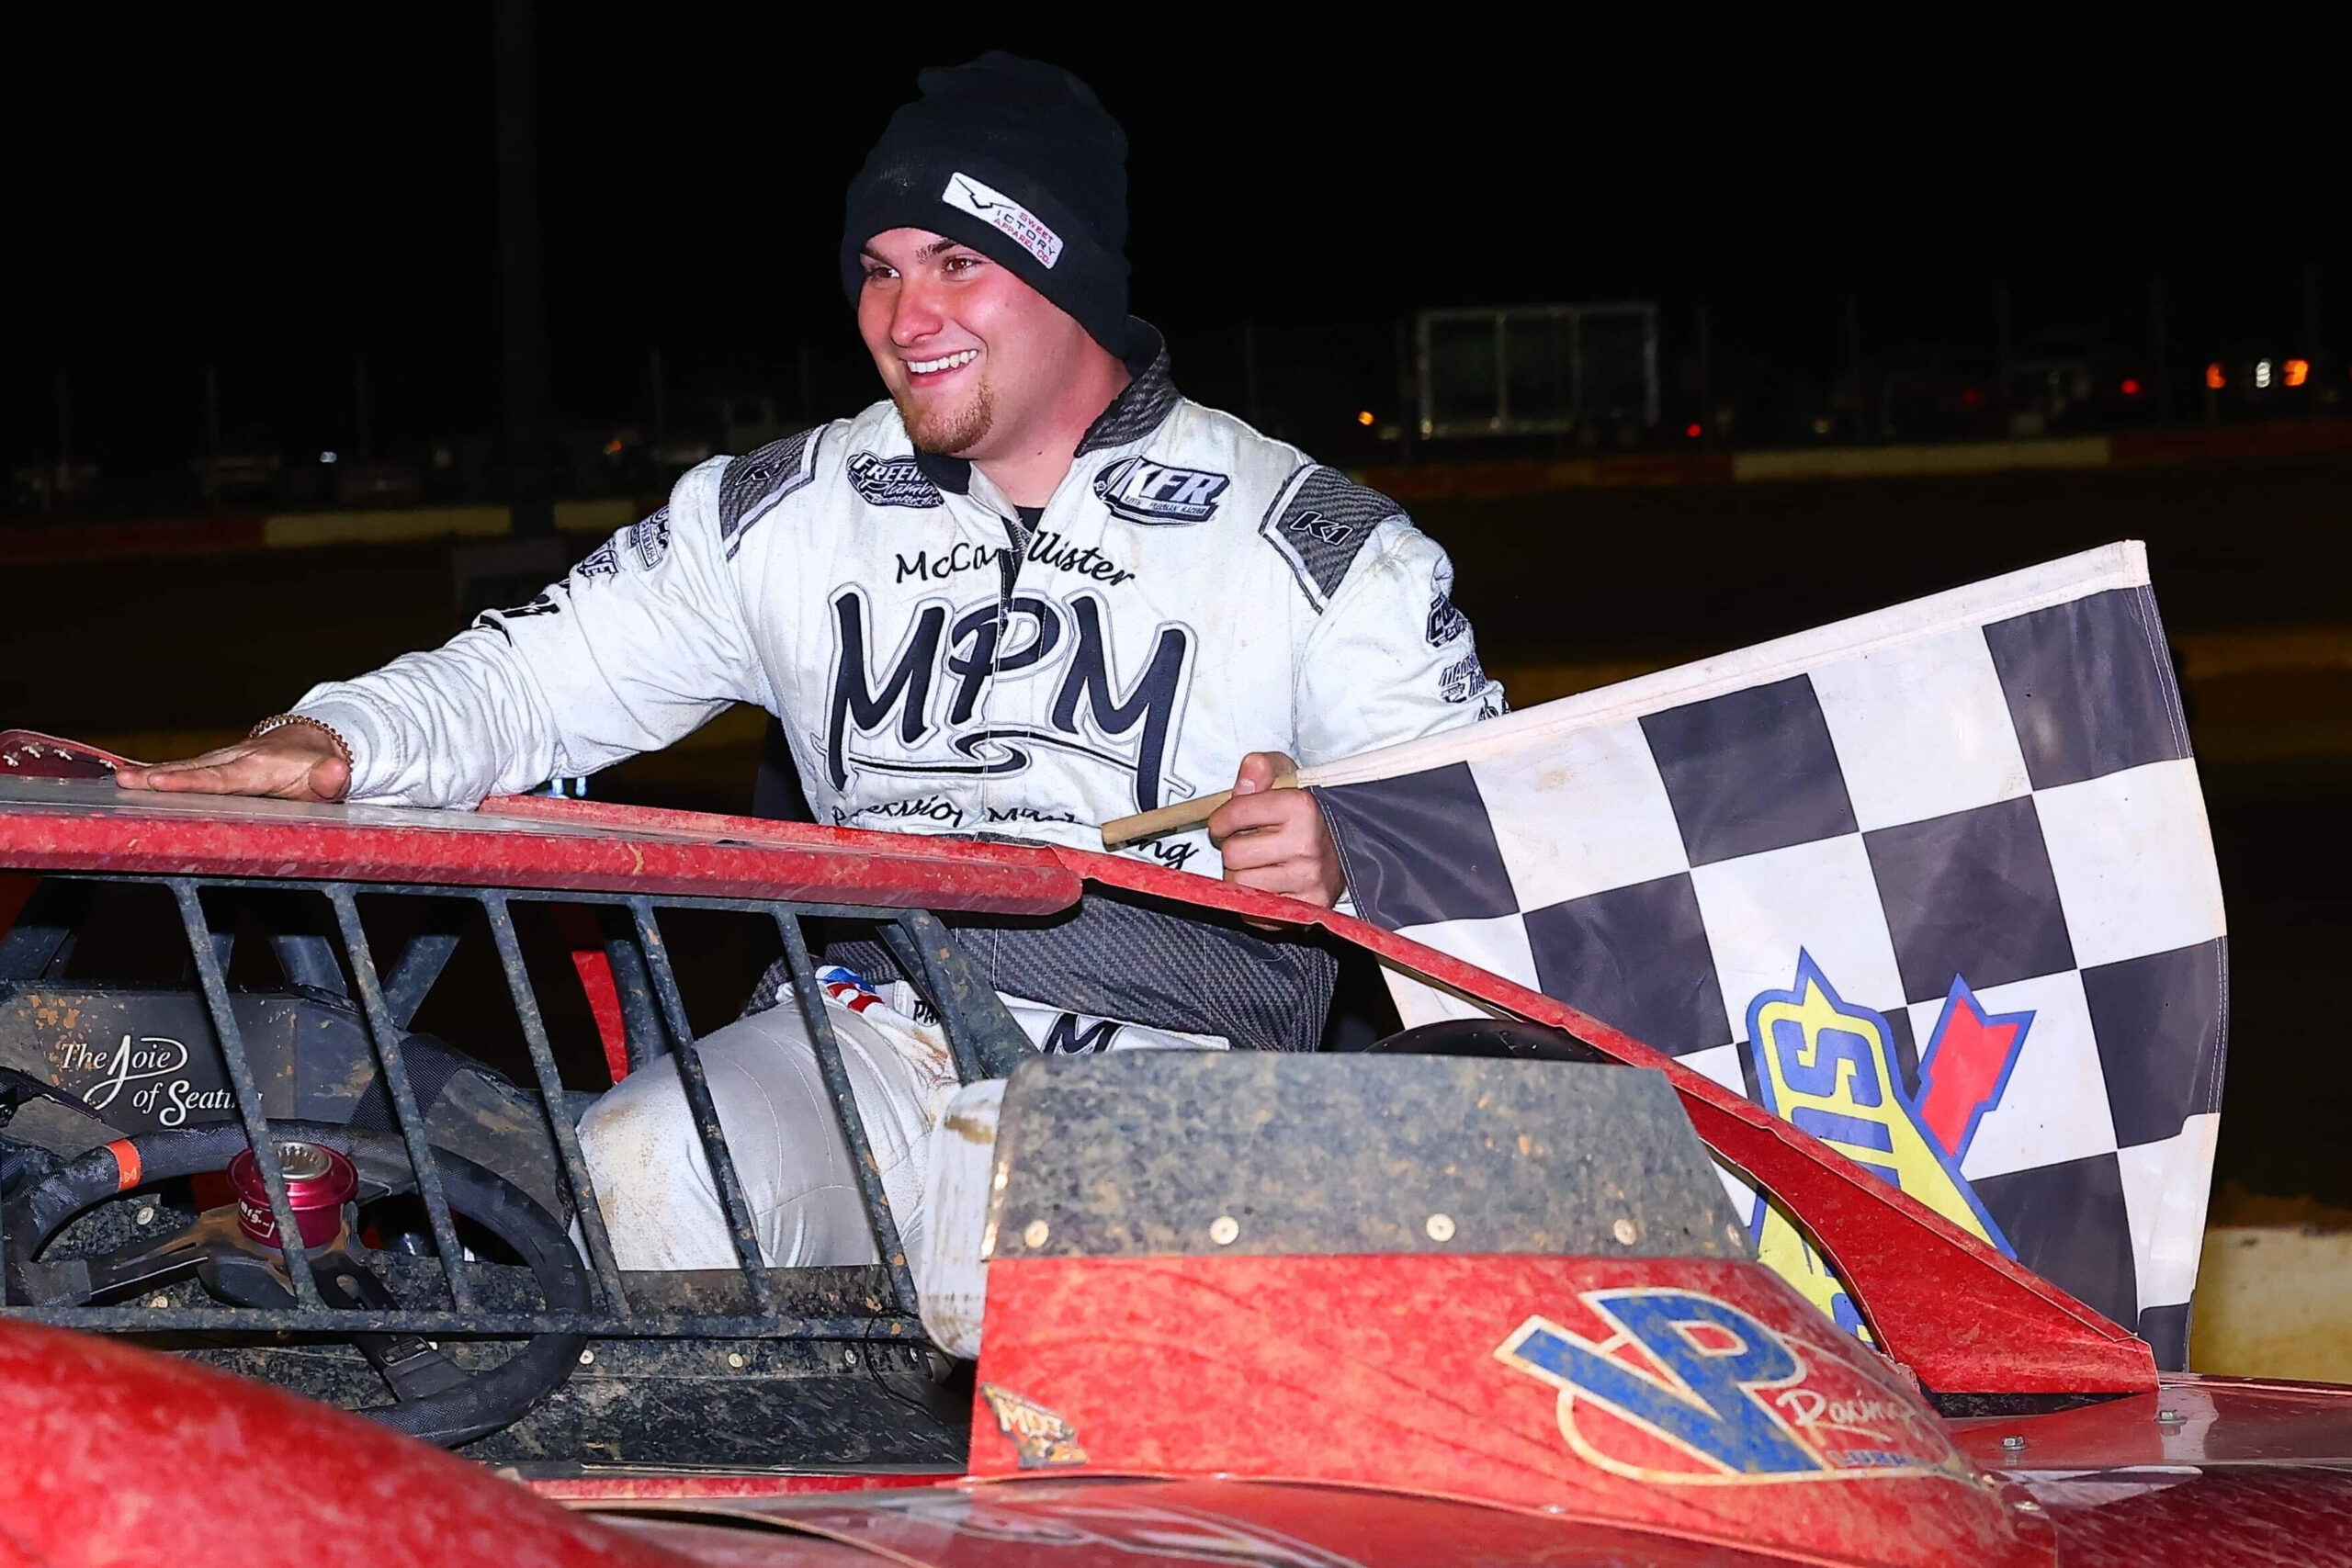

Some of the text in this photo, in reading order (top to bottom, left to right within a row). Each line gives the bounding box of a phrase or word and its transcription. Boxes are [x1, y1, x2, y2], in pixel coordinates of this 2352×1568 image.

[993, 218, 1051, 265] APPAREL CO.
[1018, 211, 1055, 243] SWEET
[853, 453, 926, 482] FREE
[858, 477, 939, 496] Plumb
[1108, 458, 1226, 505] KFR
[829, 591, 1189, 814] MPM
[60, 1043, 108, 1069] The
[132, 1080, 264, 1127] of Seati
[1492, 1287, 1827, 1475] VP
